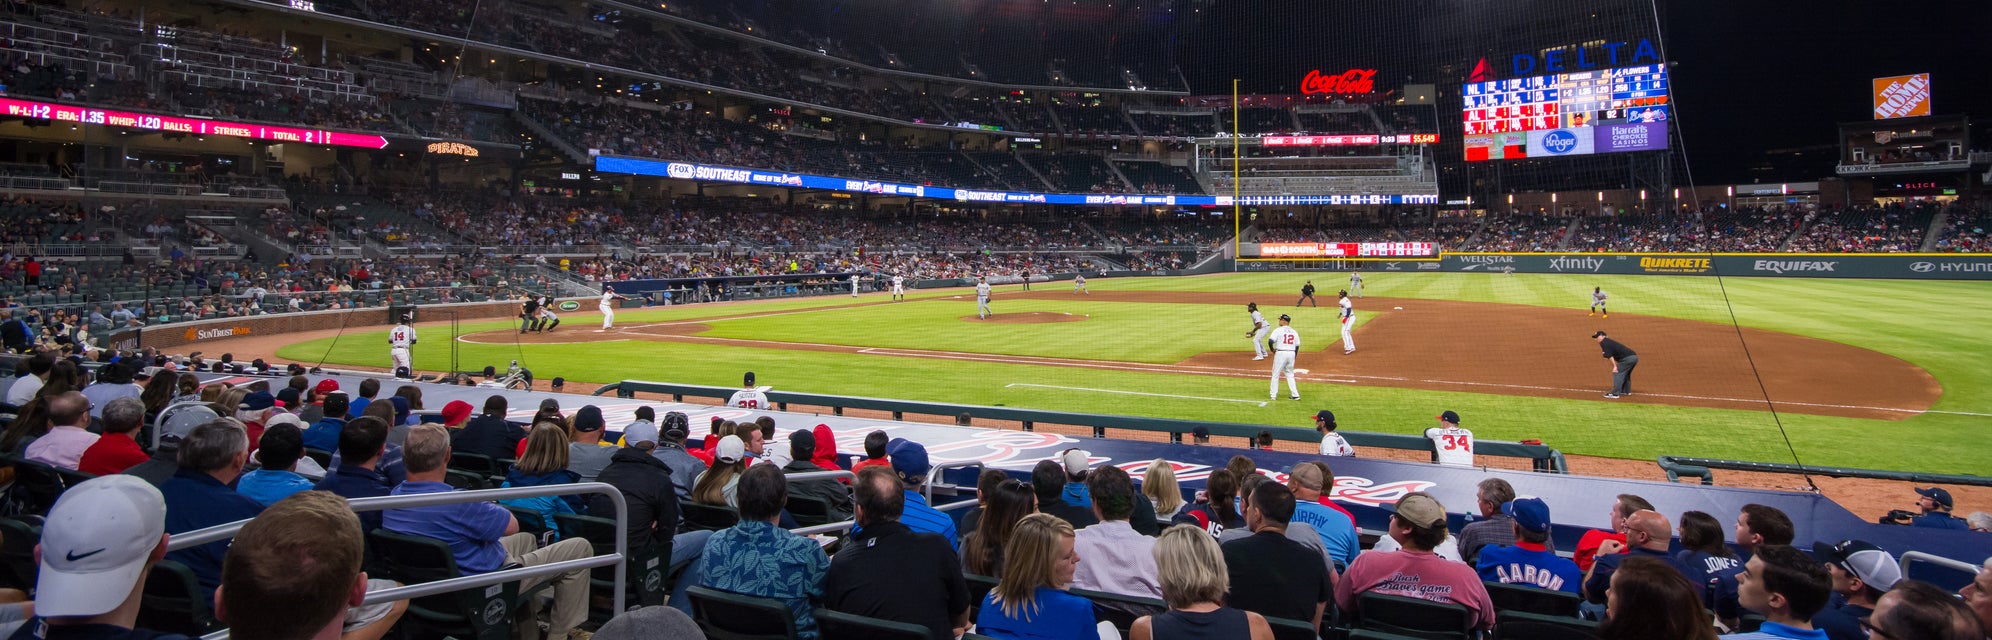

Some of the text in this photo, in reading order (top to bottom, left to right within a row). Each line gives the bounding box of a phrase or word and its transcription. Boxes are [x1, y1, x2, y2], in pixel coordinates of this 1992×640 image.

[1513, 38, 1658, 76] DELTA
[1622, 67, 1650, 76] FLOWERS
[1300, 69, 1378, 94] Coca-Cola
[1468, 84, 1480, 94] NL
[1875, 74, 1929, 118] HOME
[1880, 80, 1902, 98] THE
[1896, 90, 1928, 116] DEPOT
[1468, 111, 1480, 121] AL
[57, 110, 79, 121] ERA:
[81, 110, 105, 124] 1.35
[109, 116, 137, 126] WHIP:
[138, 116, 160, 129] 1.20
[164, 121, 192, 132] BALLS:
[214, 126, 251, 137] STRIKES:
[273, 131, 300, 142] TOTAL:
[306, 132, 312, 143] 2
[1413, 135, 1435, 143] $5,649
[1546, 134, 1575, 151] Kroger
[674, 165, 690, 174] FOX
[696, 166, 751, 182] SOUTHEAST
[846, 181, 863, 191] EVERY
[883, 184, 897, 193] GAME
[968, 192, 1006, 201] SOUTHEAST
[1460, 256, 1513, 264] WELLSTAR
[1549, 255, 1604, 271] xfinity
[1640, 257, 1711, 268] QUIKRETE
[1754, 260, 1835, 273] EQUIFAX
[394, 332, 404, 341] 14
[1283, 334, 1294, 344] 12
[1442, 435, 1470, 452] 34
[1291, 509, 1328, 529] URPHY
[1496, 563, 1564, 591] AARON
[1419, 584, 1451, 595] game
